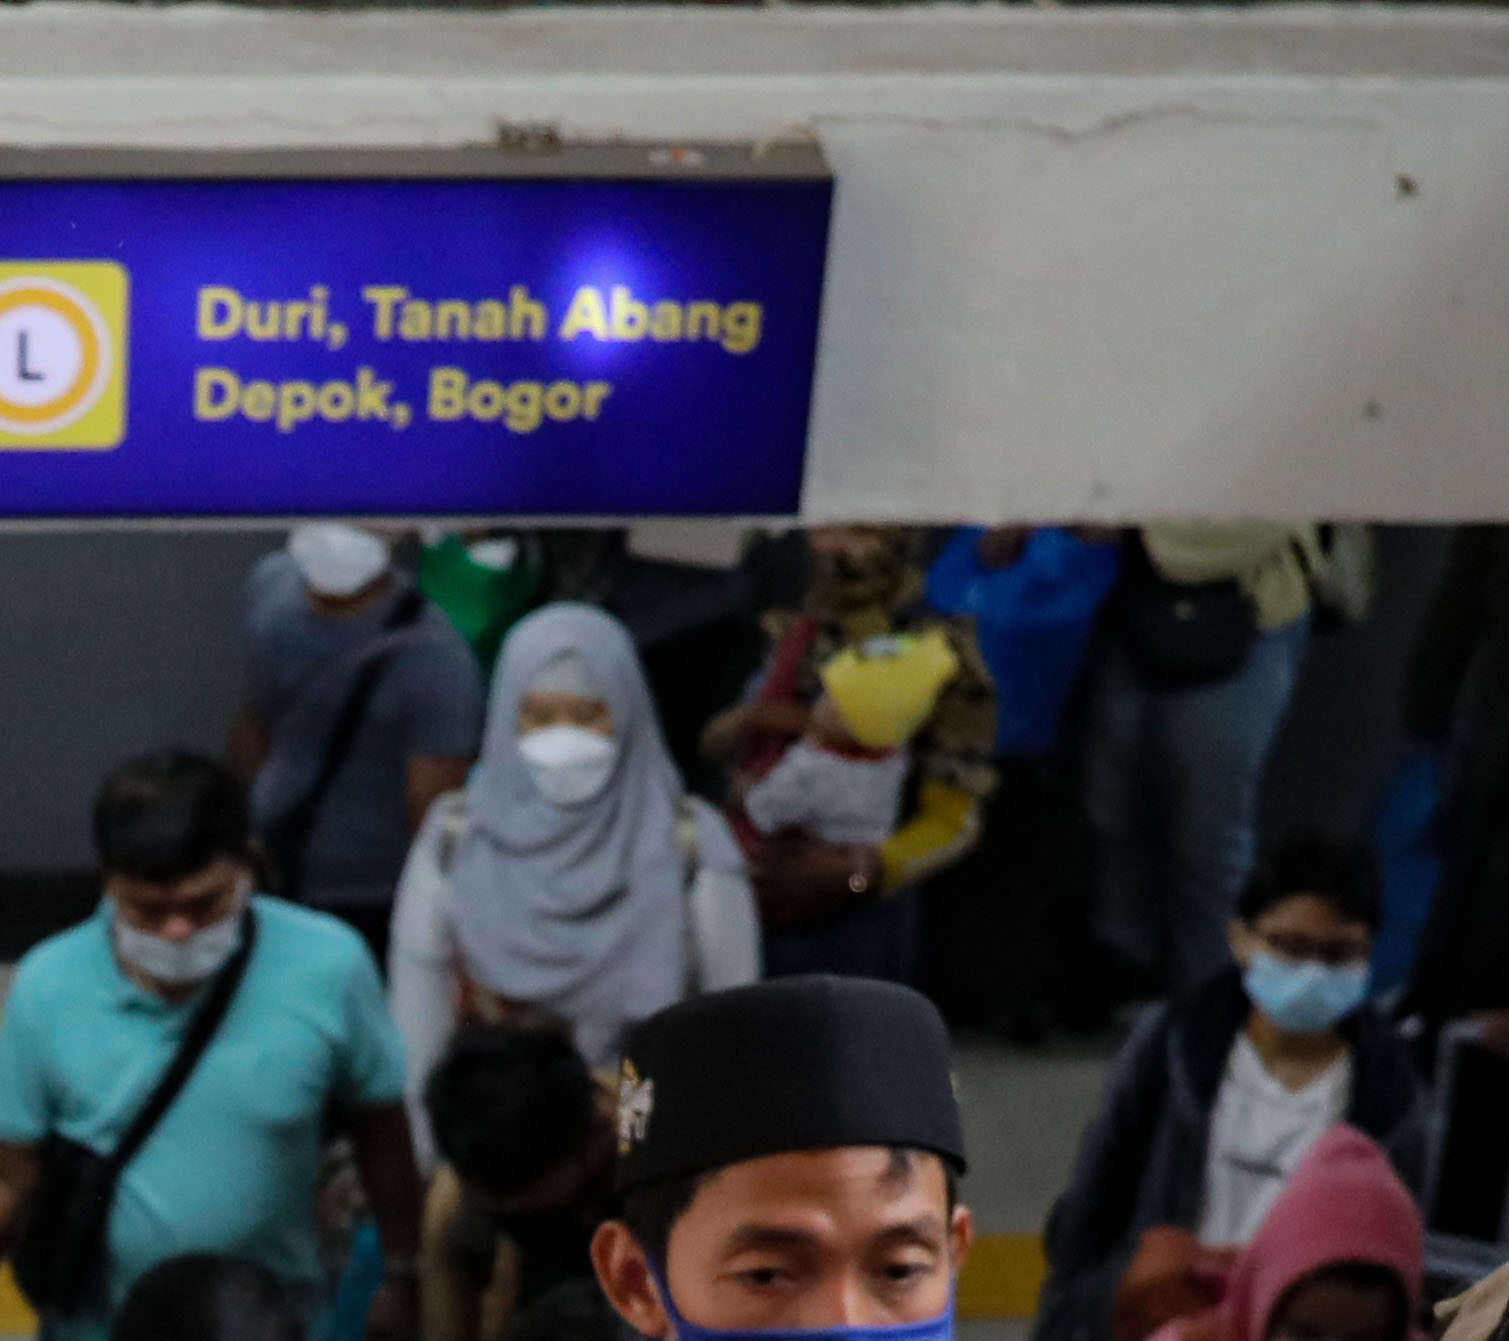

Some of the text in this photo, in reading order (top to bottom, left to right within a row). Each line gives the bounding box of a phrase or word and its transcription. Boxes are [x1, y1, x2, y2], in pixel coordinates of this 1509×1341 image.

[194, 284, 764, 352] Duri, Tanah Abang
[13, 329, 45, 385] L
[194, 368, 610, 432] Depok, Bogor
